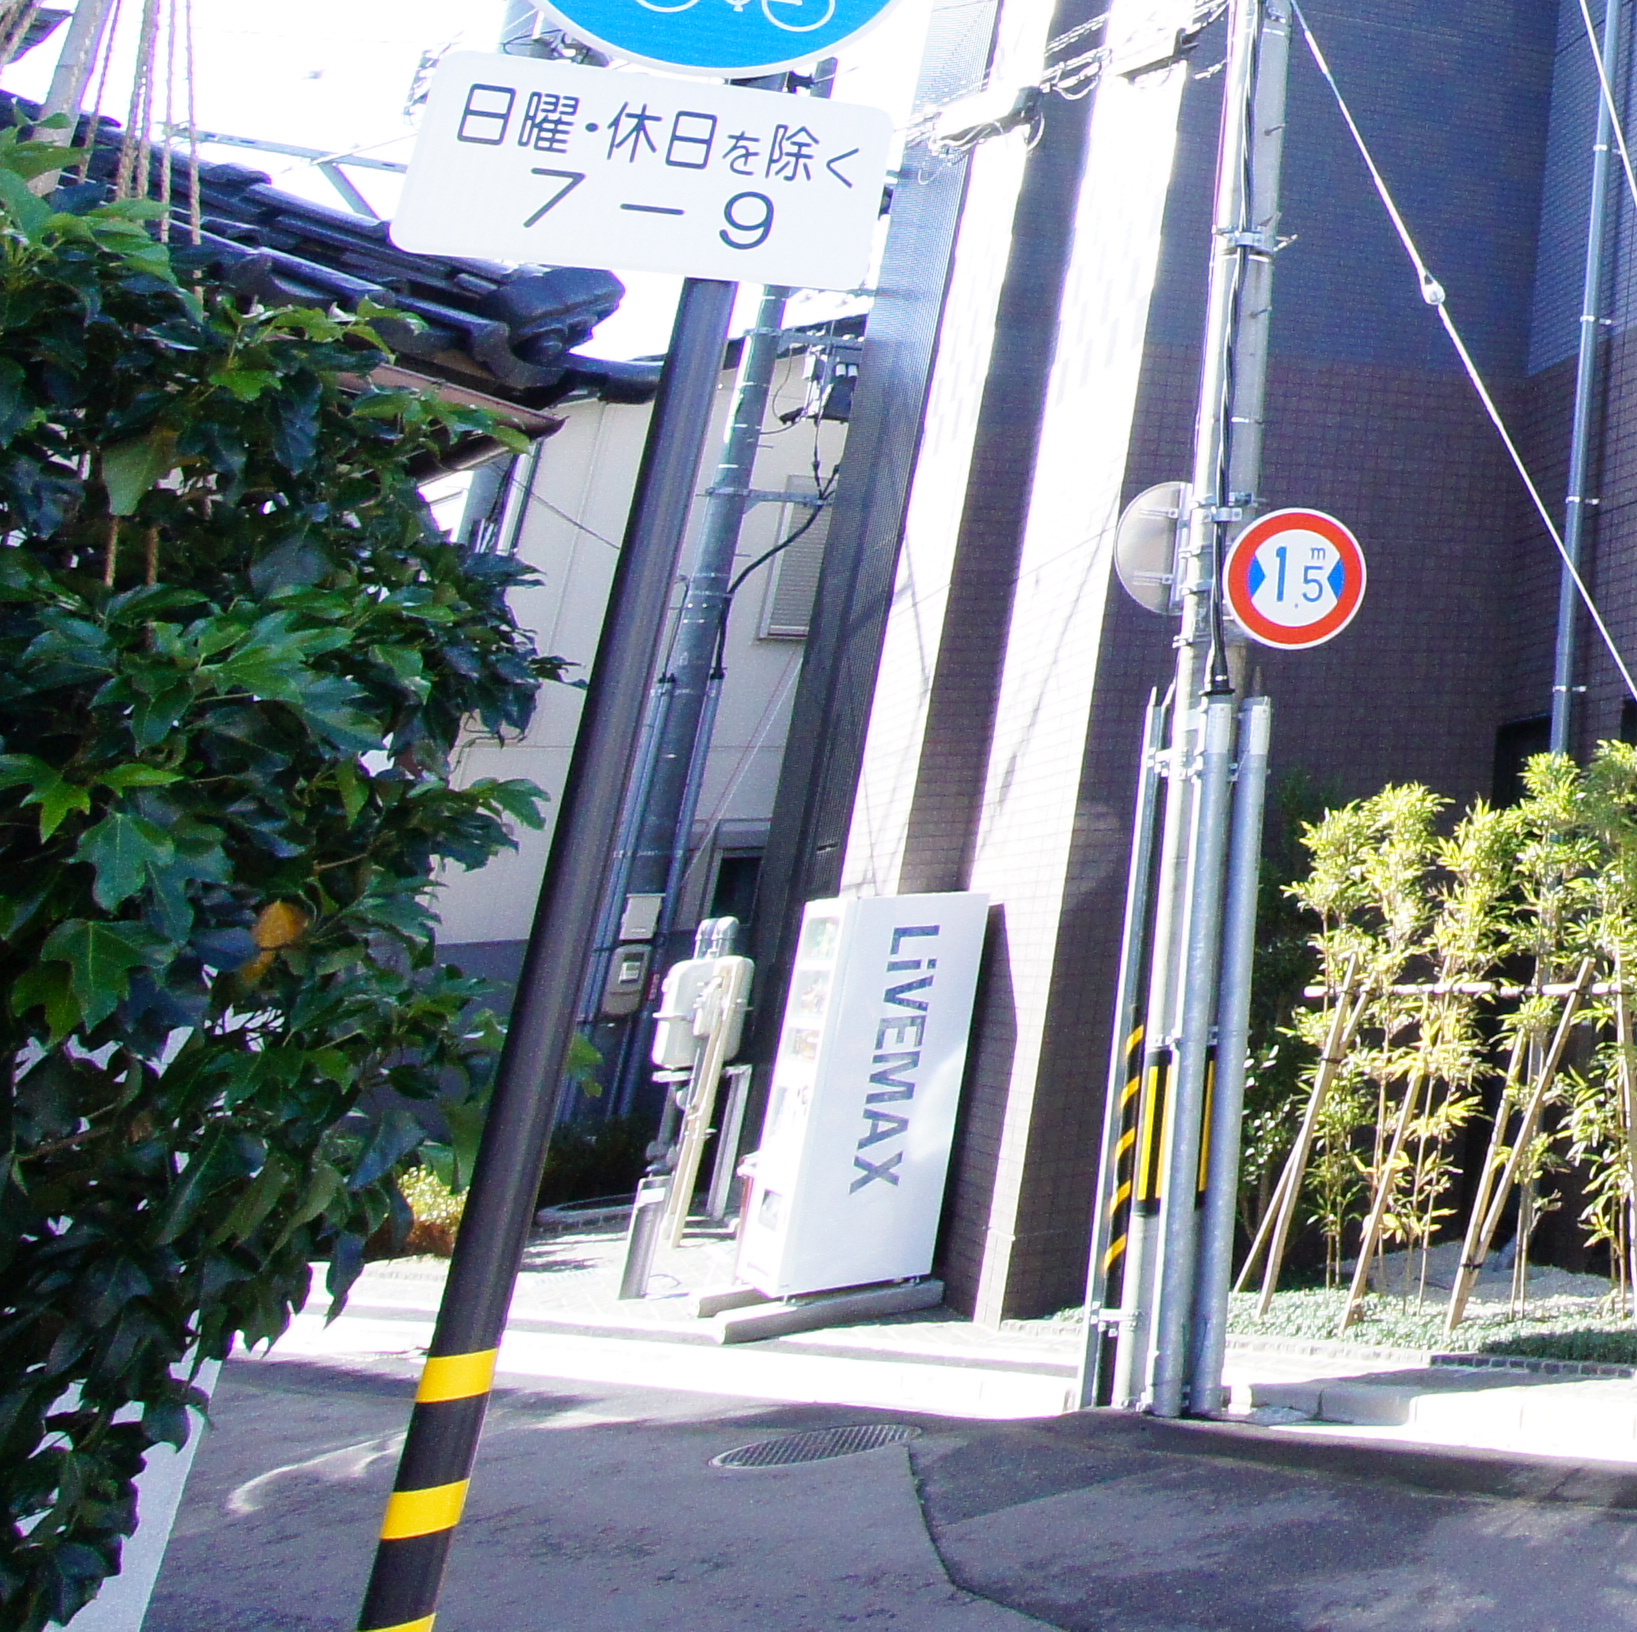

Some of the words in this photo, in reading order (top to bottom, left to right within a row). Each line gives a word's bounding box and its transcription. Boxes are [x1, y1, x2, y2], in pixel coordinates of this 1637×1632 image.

[456, 82, 861, 190] 日曜・休日を除く
